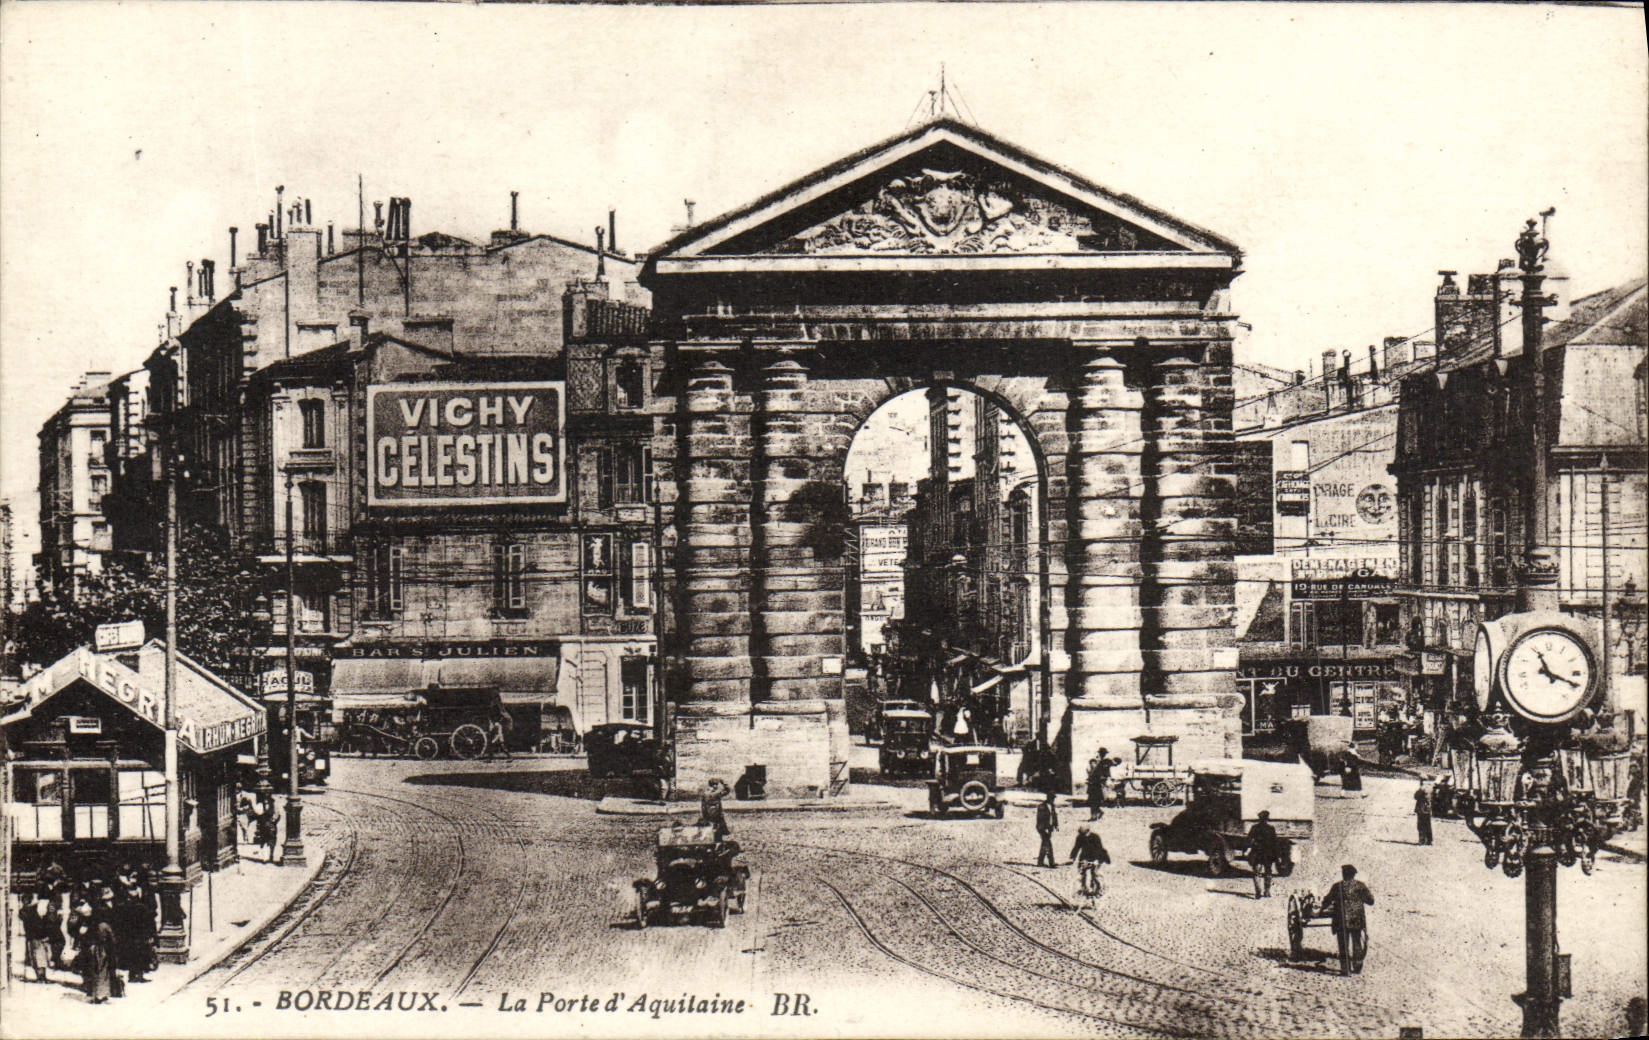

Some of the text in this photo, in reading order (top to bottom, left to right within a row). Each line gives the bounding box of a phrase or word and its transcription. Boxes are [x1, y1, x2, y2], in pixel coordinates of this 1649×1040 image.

[399, 395, 533, 427] VICHY
[376, 430, 554, 488] CÉLESTINS
[352, 649, 400, 657] BAR
[439, 646, 539, 656] JULIEN
[1270, 666, 1299, 677] DU
[79, 648, 198, 748] NEGRIA
